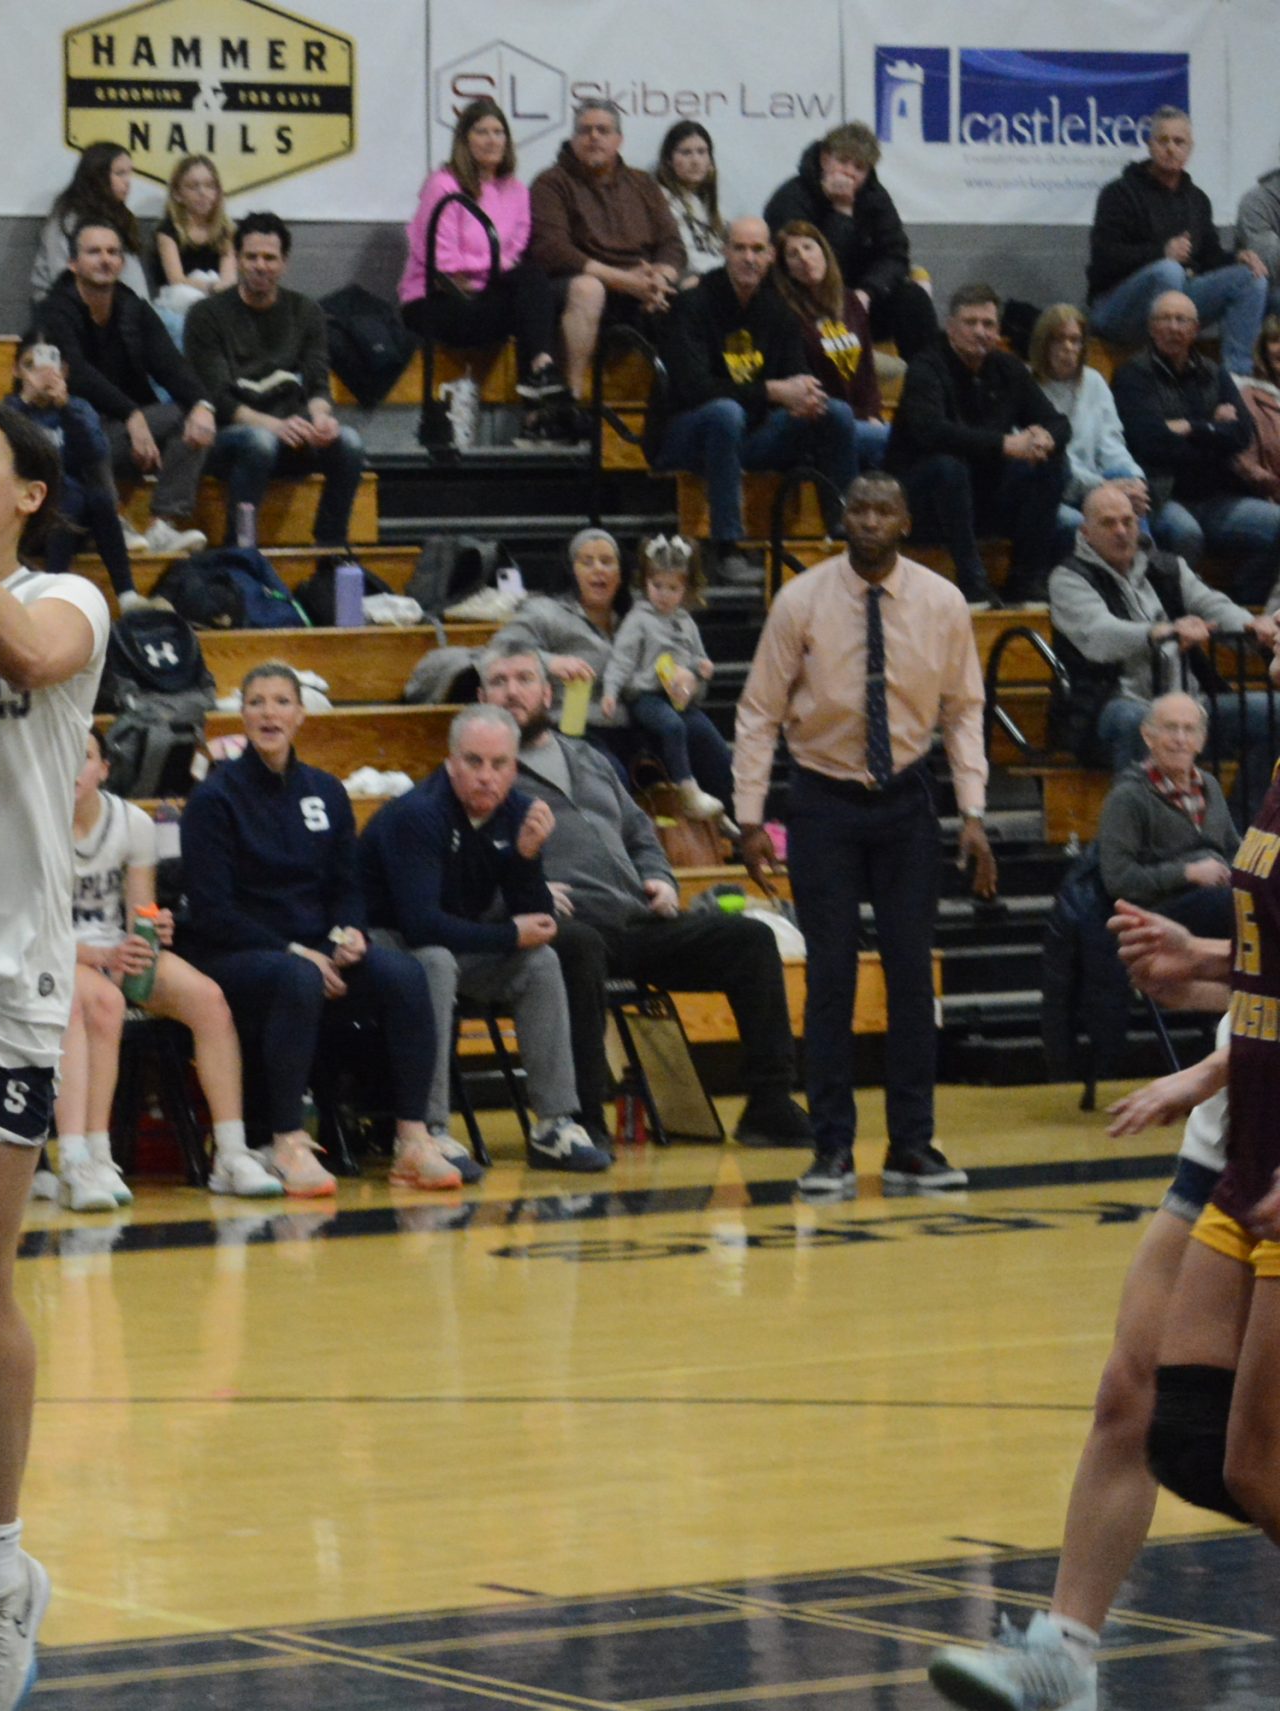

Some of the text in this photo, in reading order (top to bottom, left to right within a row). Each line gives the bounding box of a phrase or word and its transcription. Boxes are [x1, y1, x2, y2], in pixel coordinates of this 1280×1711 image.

[91, 34, 328, 72] HAMMER
[94, 86, 183, 103] GROOMING
[238, 88, 321, 106] FOR GUYS
[569, 79, 834, 120] Skiber Law
[128, 121, 294, 155] NAILS
[961, 95, 1152, 148] castlekee
[299, 796, 330, 832] S
[4, 1079, 30, 1114] S
